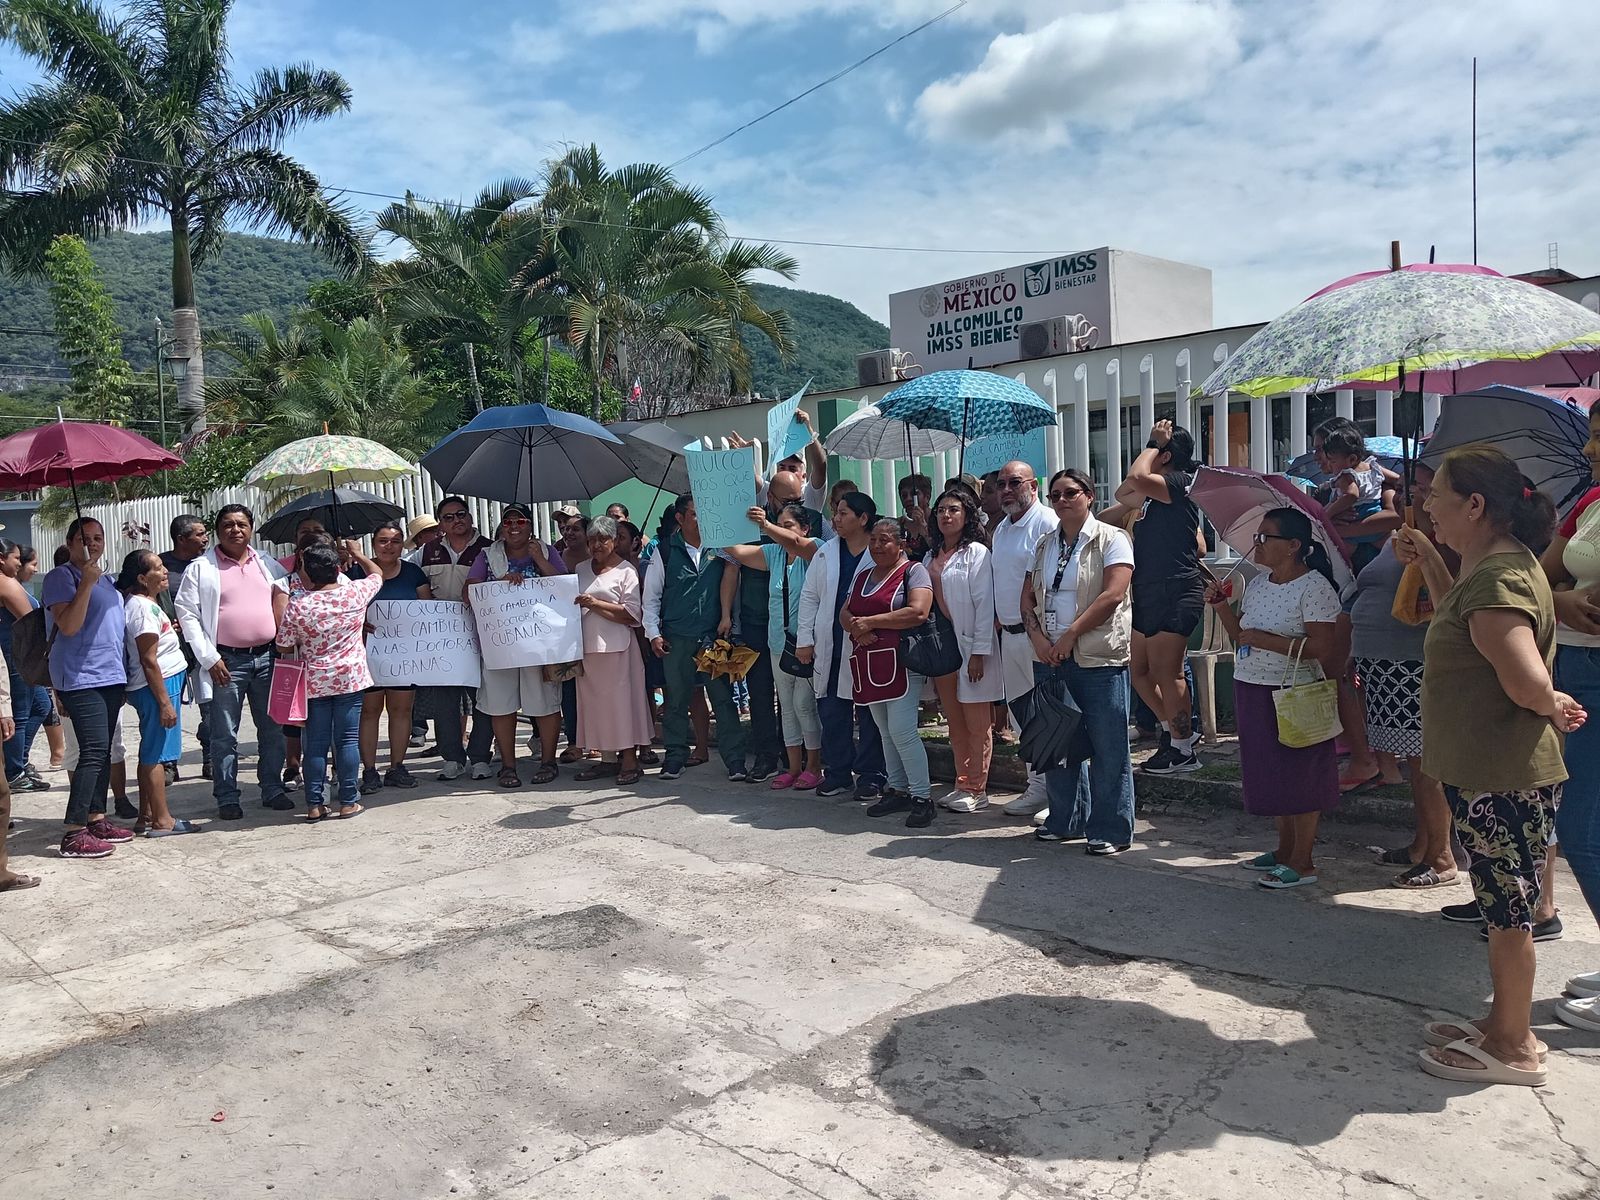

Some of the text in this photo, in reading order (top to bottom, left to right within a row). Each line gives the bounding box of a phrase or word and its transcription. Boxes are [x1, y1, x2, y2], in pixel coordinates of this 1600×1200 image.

[1054, 253, 1098, 278] IMSS
[943, 272, 1006, 294] GOBIERNO DE
[1054, 273, 1097, 290] BIENESTAR
[943, 282, 1017, 314] MÉXICO
[927, 306, 1024, 338] JALCOMULCO
[927, 335, 964, 355] IMSS
[723, 471, 752, 487] QUE
[728, 489, 751, 506] LAS
[475, 584, 489, 602] NO
[375, 601, 402, 620] NO
[480, 594, 557, 618] QUE CAMBIEN A
[373, 619, 475, 639] QUE CAMBIEN
[483, 610, 547, 632] LAS DOCTORAS
[491, 620, 552, 646] CUBANAS
[371, 637, 481, 657] A LAS DOCTORAS
[379, 656, 453, 678] CUBANAS
